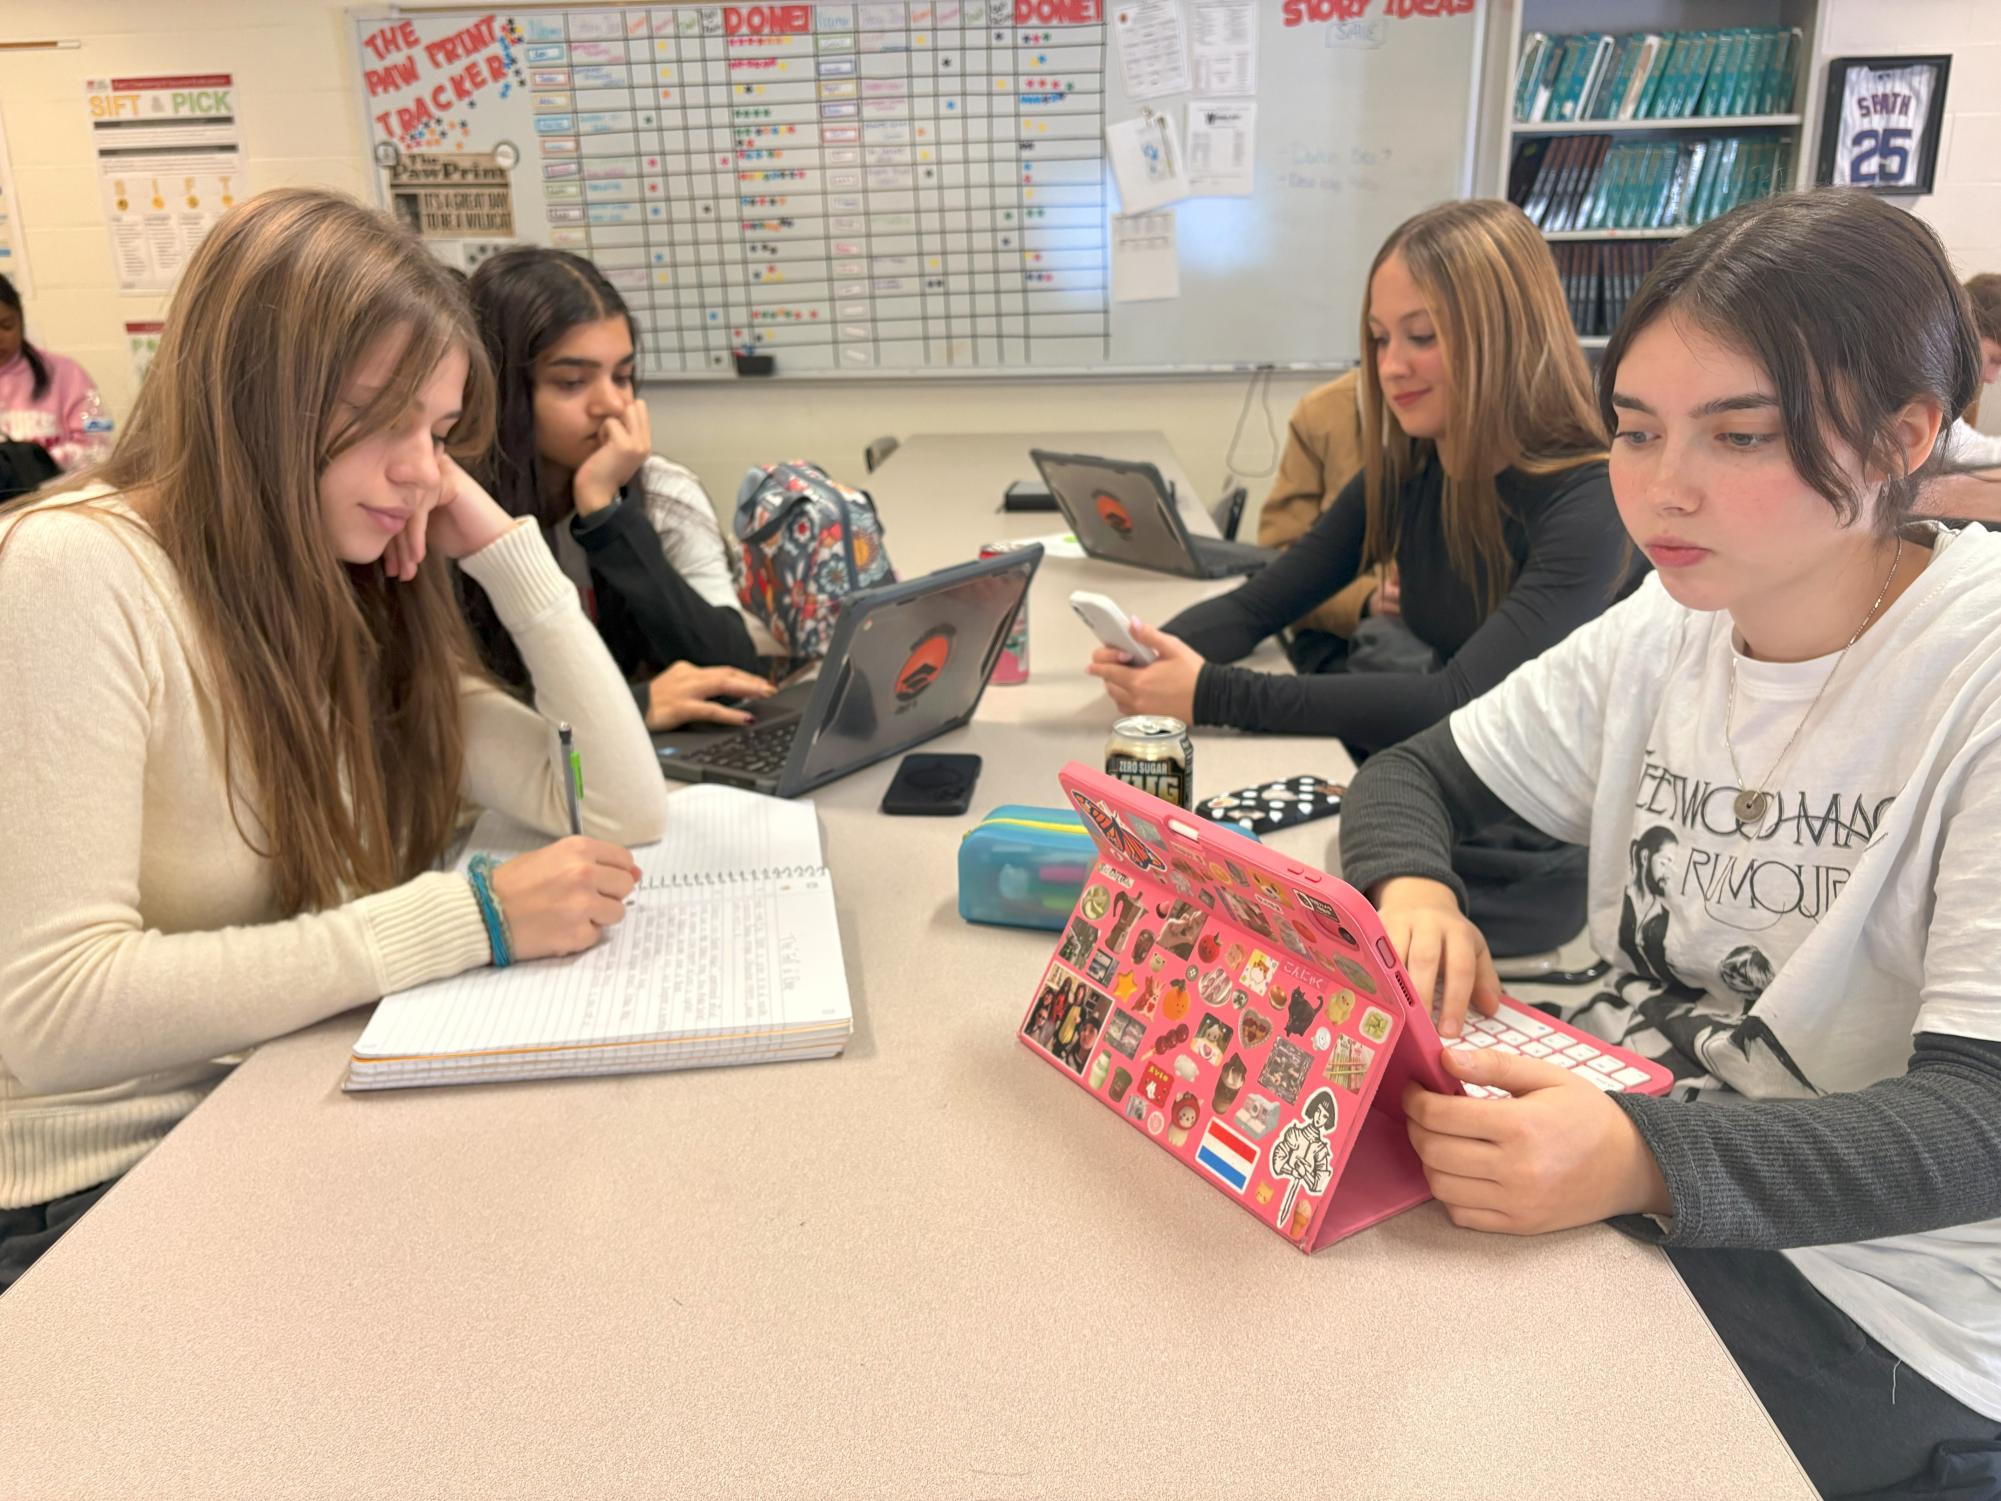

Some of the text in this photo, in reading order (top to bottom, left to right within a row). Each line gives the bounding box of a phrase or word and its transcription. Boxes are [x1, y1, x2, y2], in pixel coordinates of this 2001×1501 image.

[1015, 0, 1102, 24] DONE!
[1282, 0, 1475, 27] STORY IDEAS
[364, 19, 421, 61] THE
[365, 55, 420, 97] PAW
[424, 15, 497, 68] PRINT
[89, 94, 141, 117] SIFT
[171, 91, 233, 114] PICK
[376, 55, 508, 139] TRACKER
[1850, 128, 1913, 184] 25
[1119, 760, 1168, 775] ZERO SUGAR
